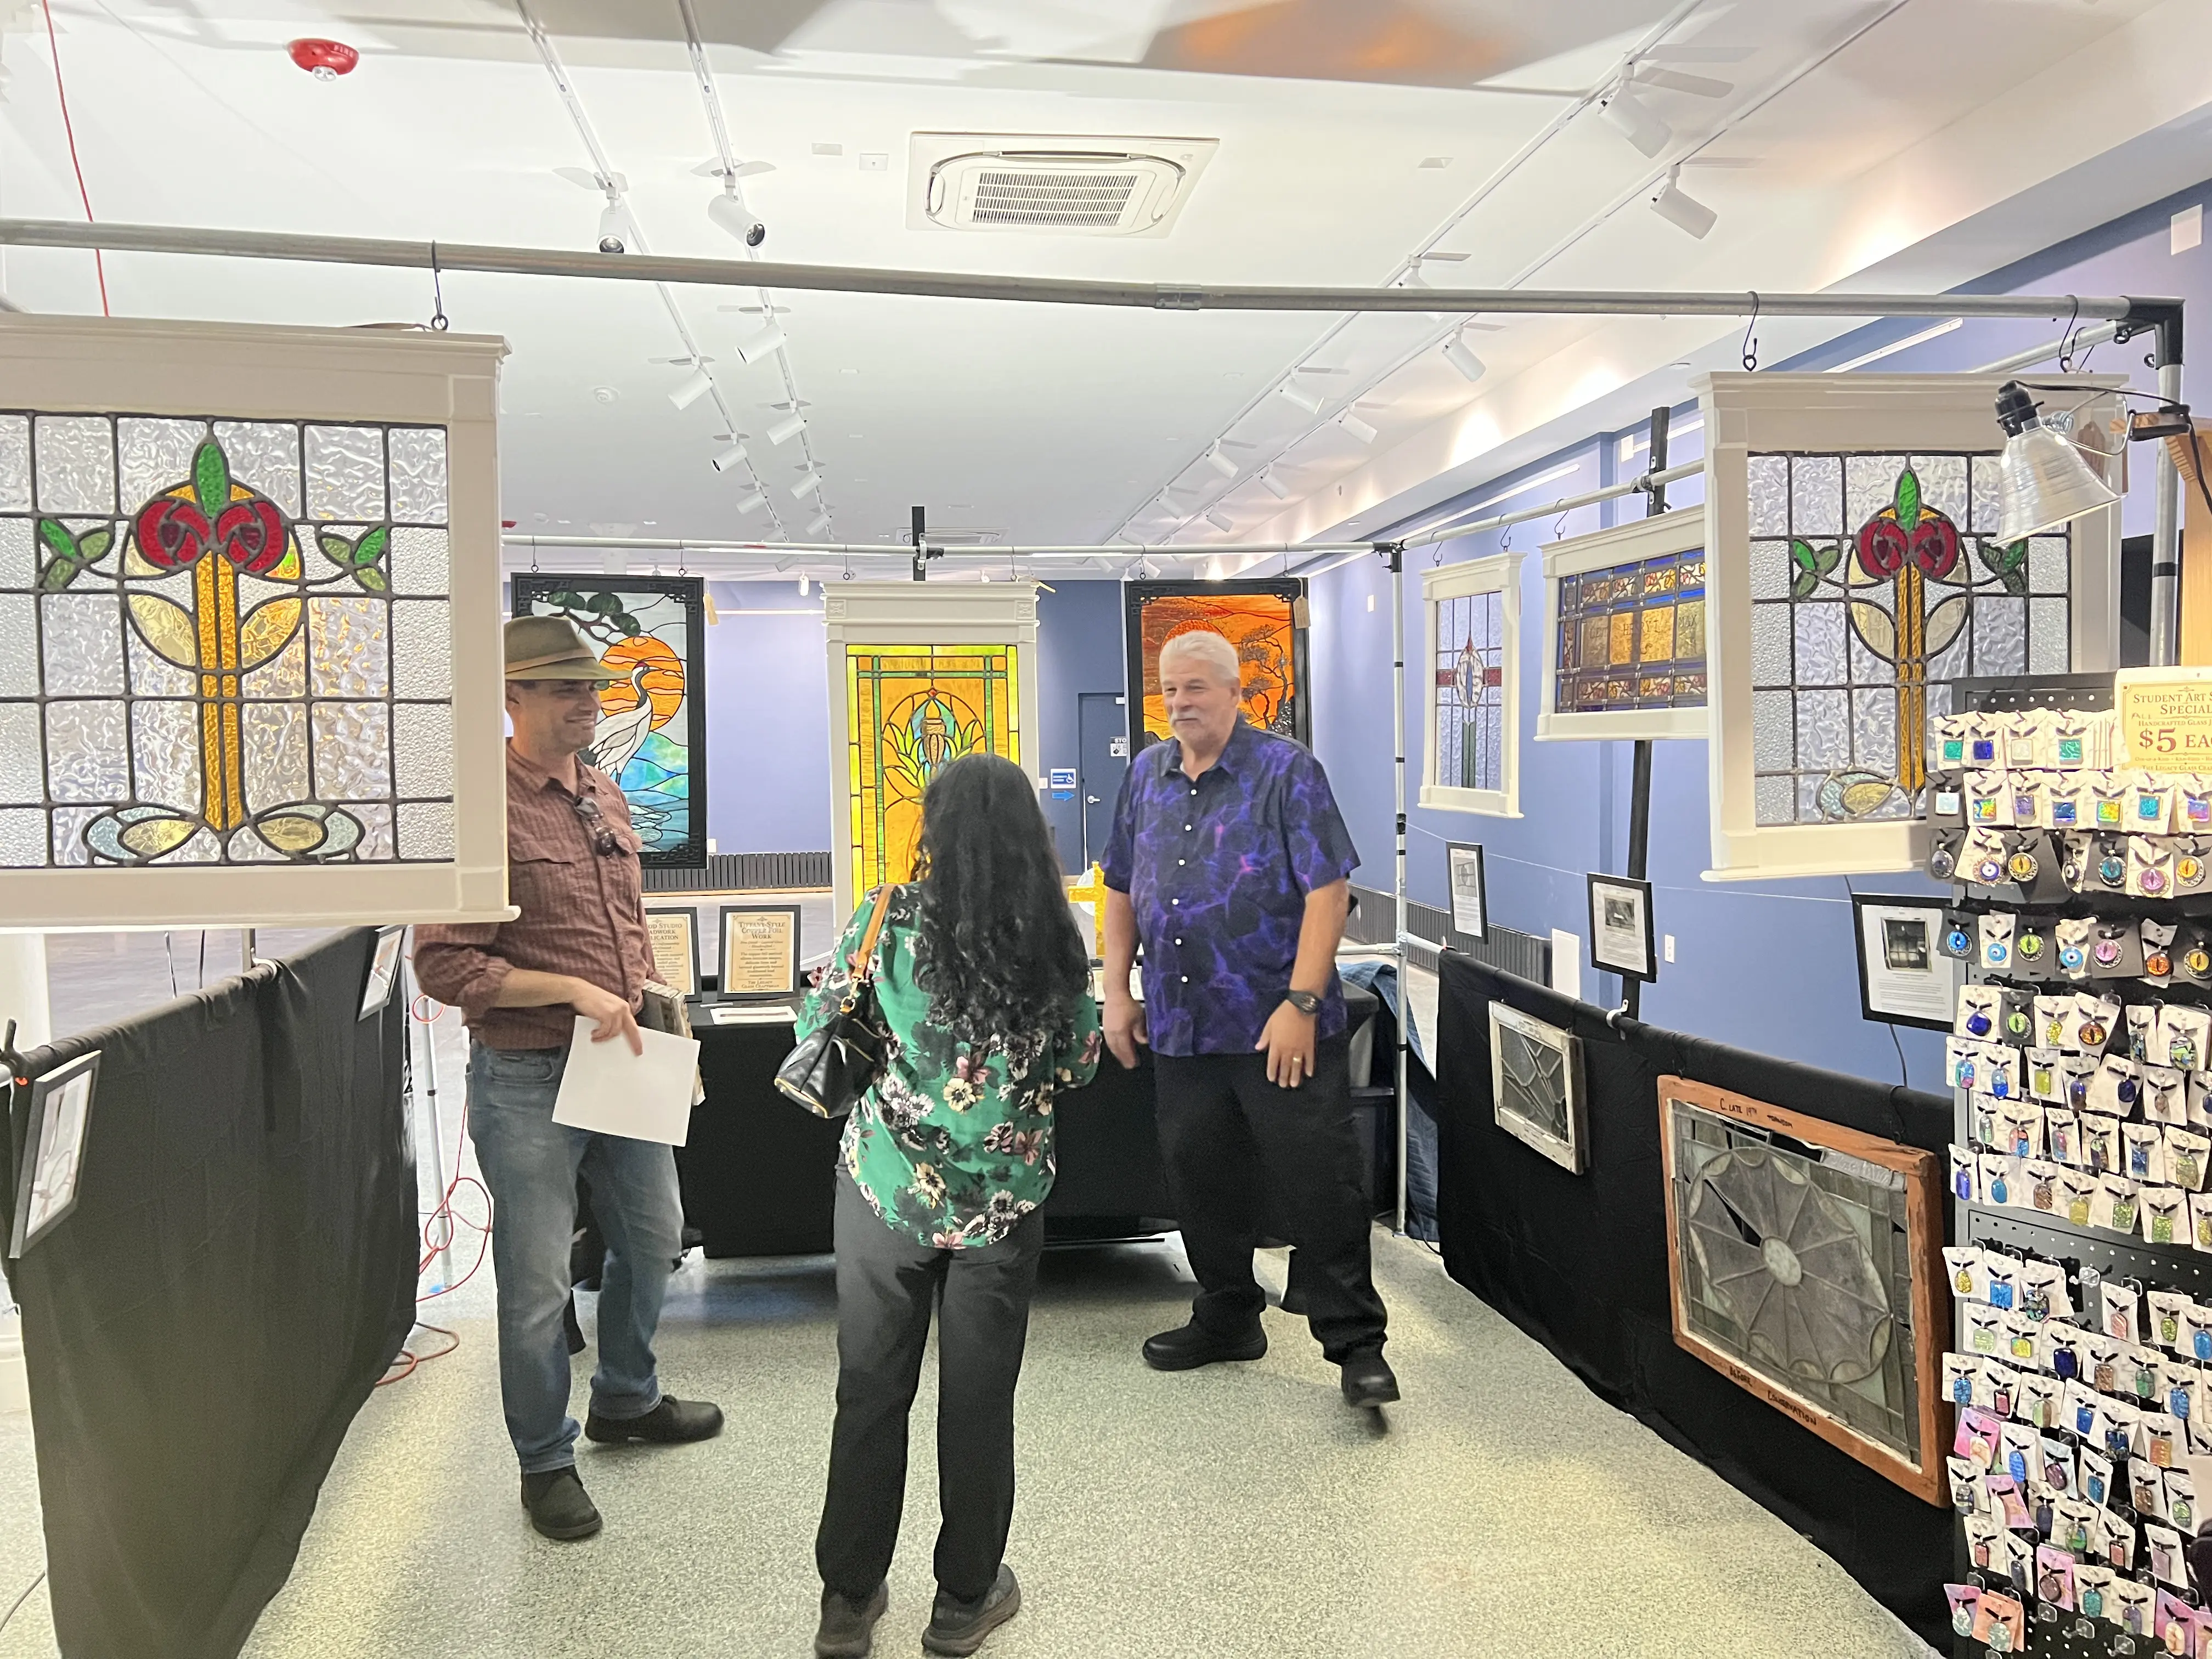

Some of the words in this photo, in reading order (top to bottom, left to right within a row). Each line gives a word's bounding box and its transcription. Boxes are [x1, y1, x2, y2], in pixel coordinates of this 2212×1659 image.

[2133, 693, 2182, 704] STUDENT
[2185, 692, 2207, 702] ART
[2160, 704, 2212, 715] SPECIAL
[2139, 727, 2176, 753] $5
[2185, 734, 2212, 748] EA
